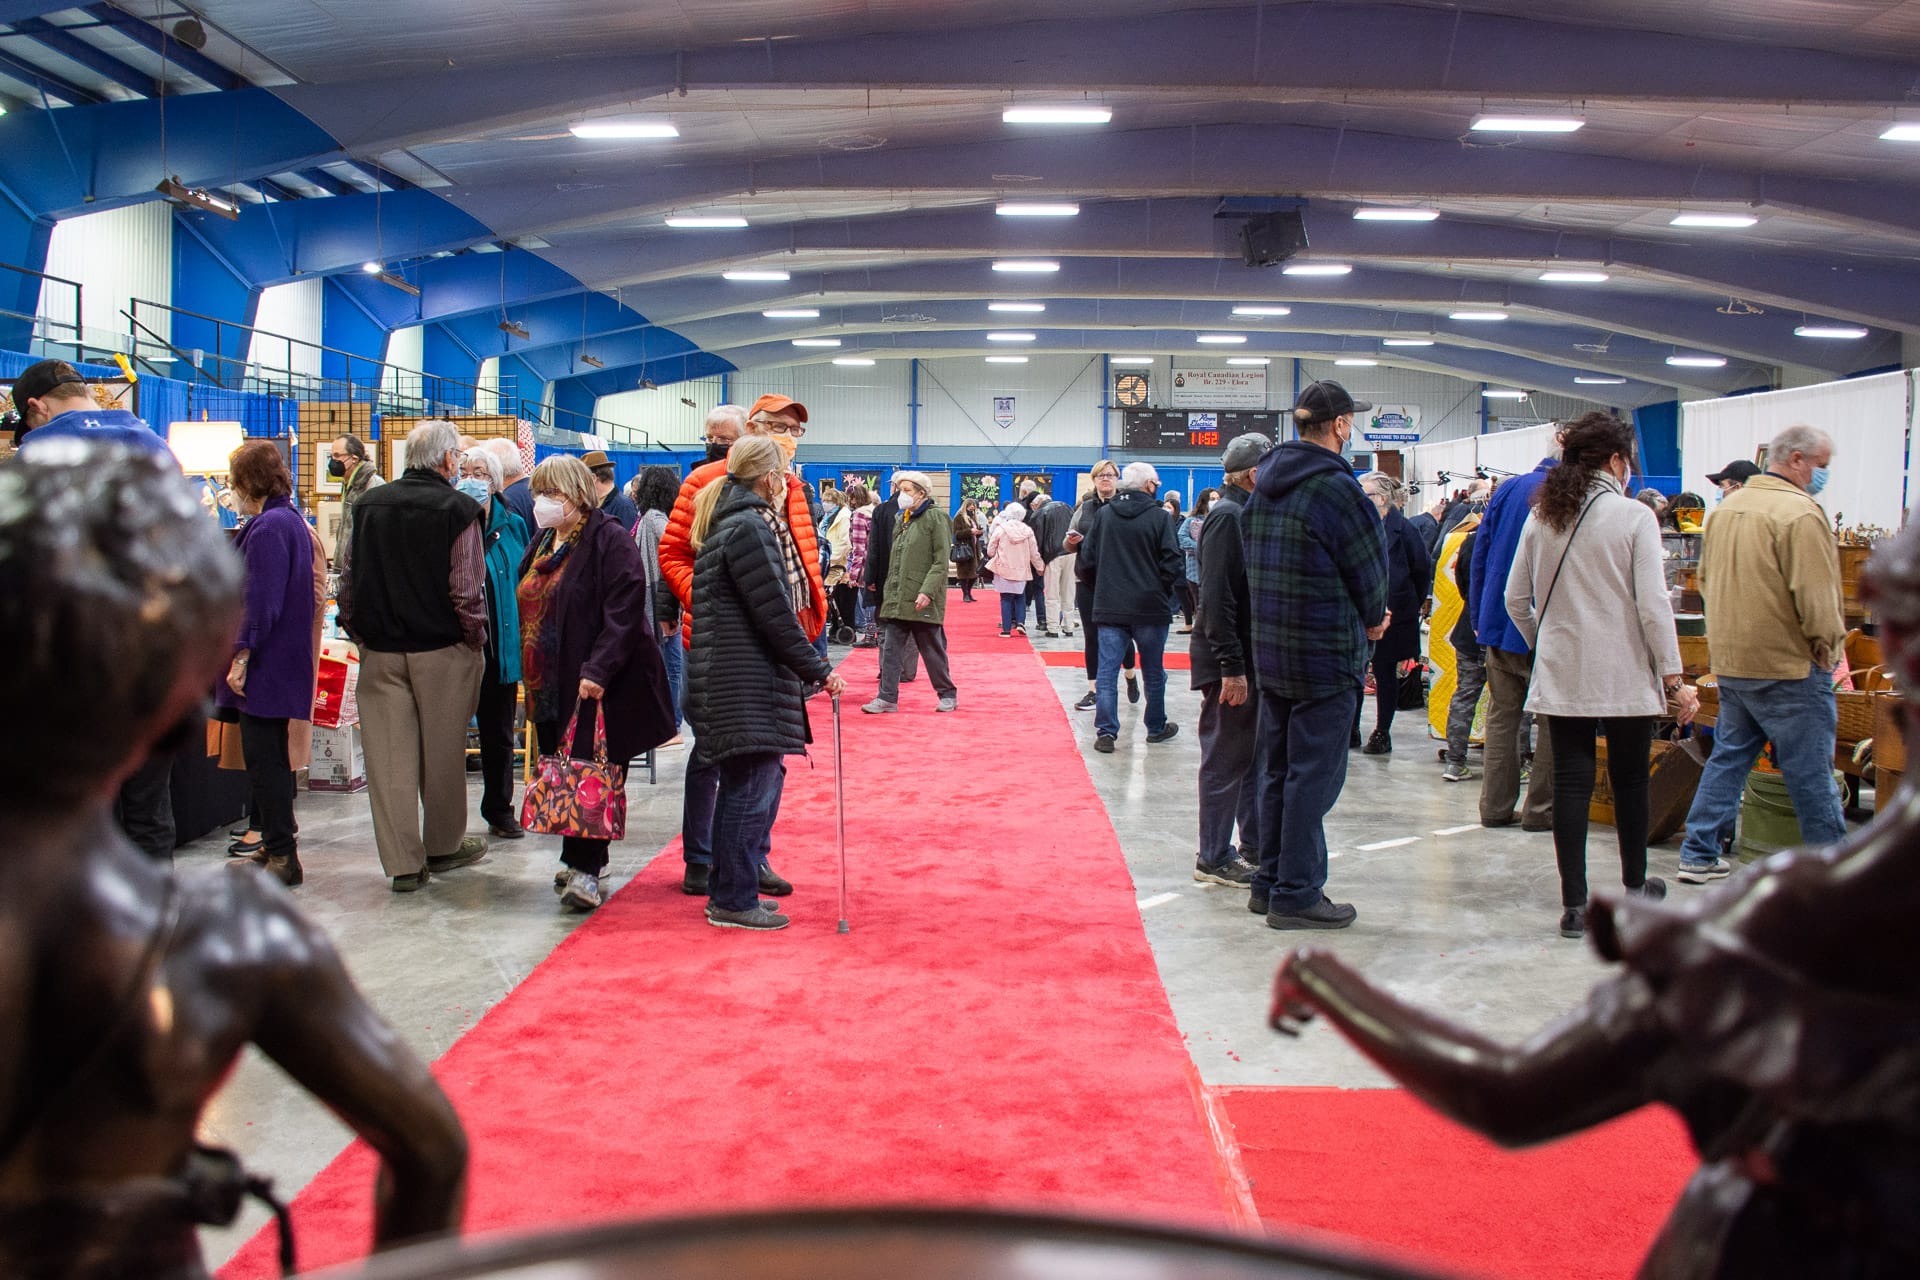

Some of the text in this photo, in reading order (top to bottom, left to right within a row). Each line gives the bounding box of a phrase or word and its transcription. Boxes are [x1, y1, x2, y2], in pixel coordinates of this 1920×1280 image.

[1187, 371, 1264, 380] Royal Canadian Legion
[1191, 431, 1219, 445] 11:52
